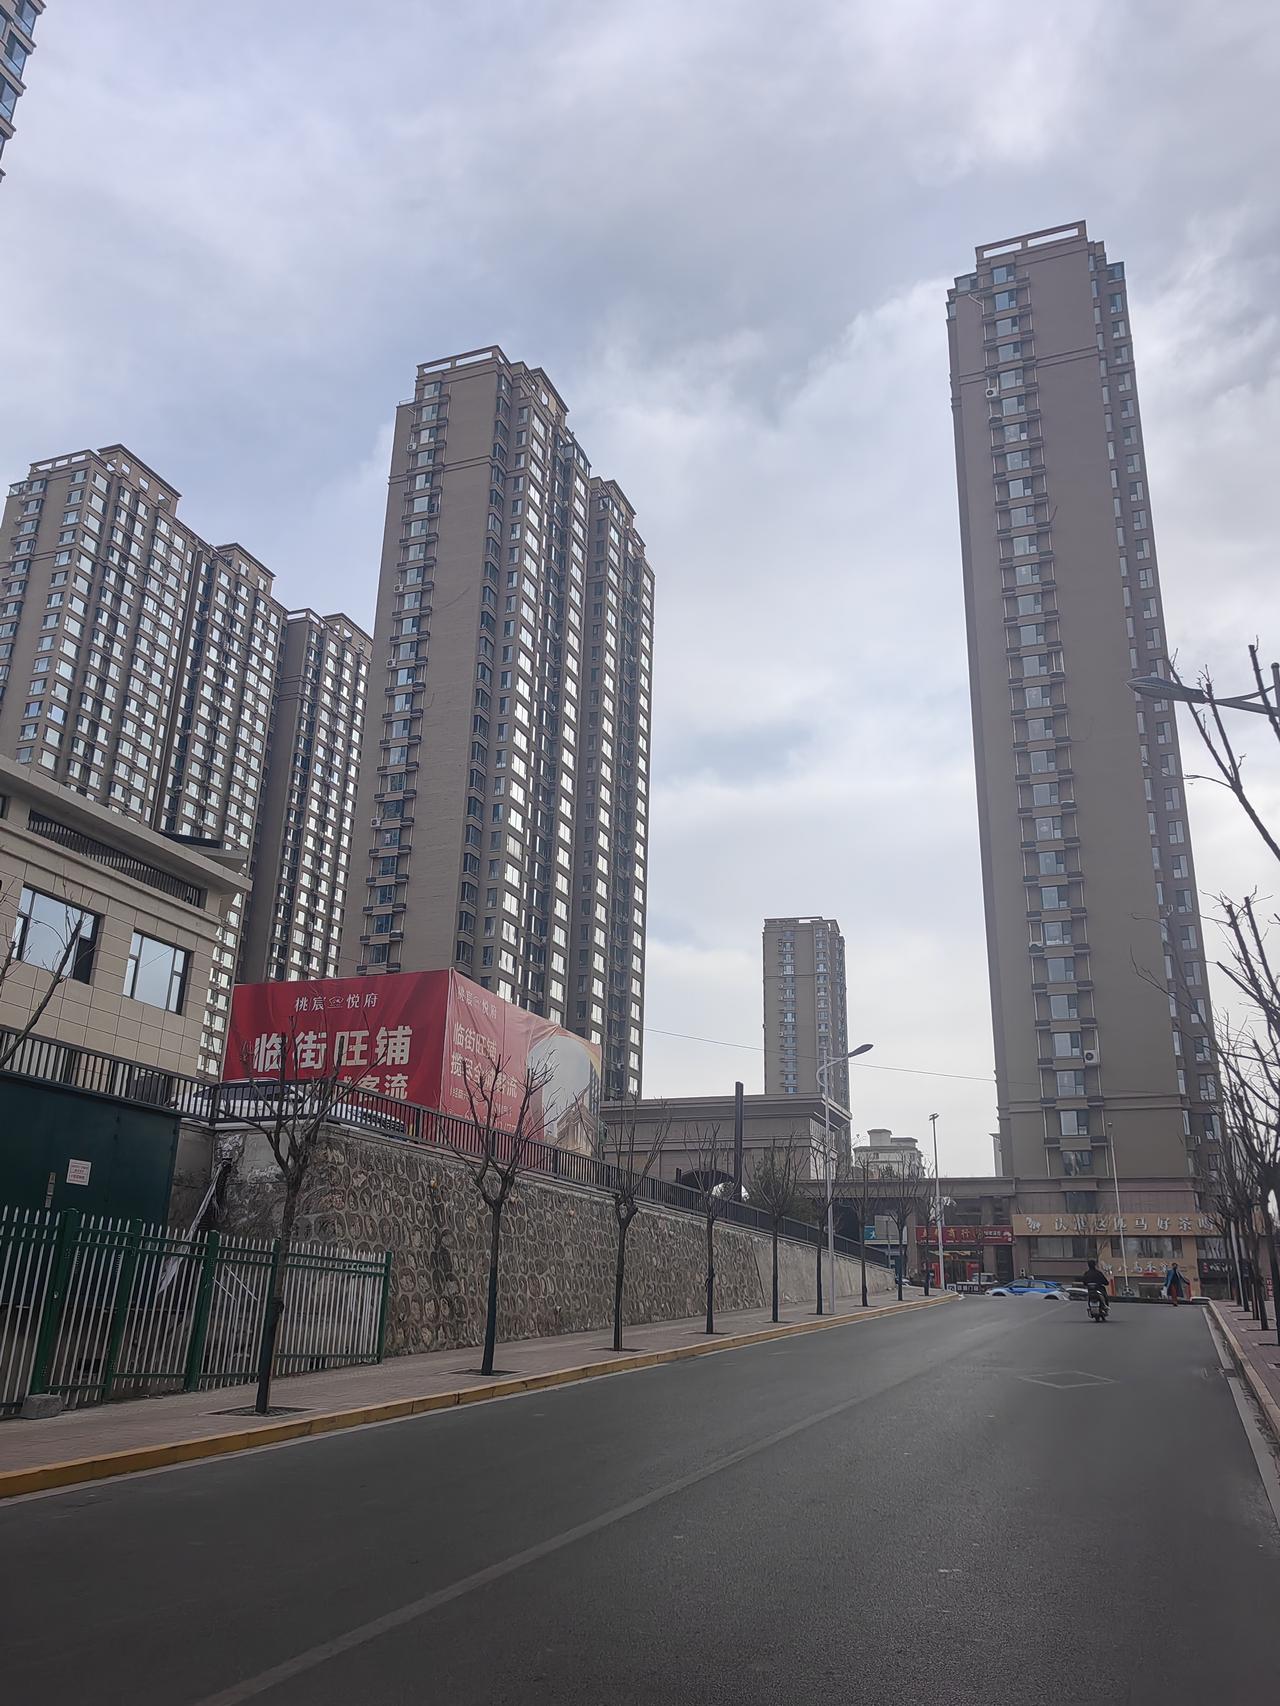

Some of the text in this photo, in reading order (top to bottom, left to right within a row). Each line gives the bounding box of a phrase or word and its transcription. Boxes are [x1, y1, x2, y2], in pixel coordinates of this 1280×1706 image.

[253, 1025, 413, 1072] 临街旺铺
[453, 1022, 497, 1061] 临街旺铺
